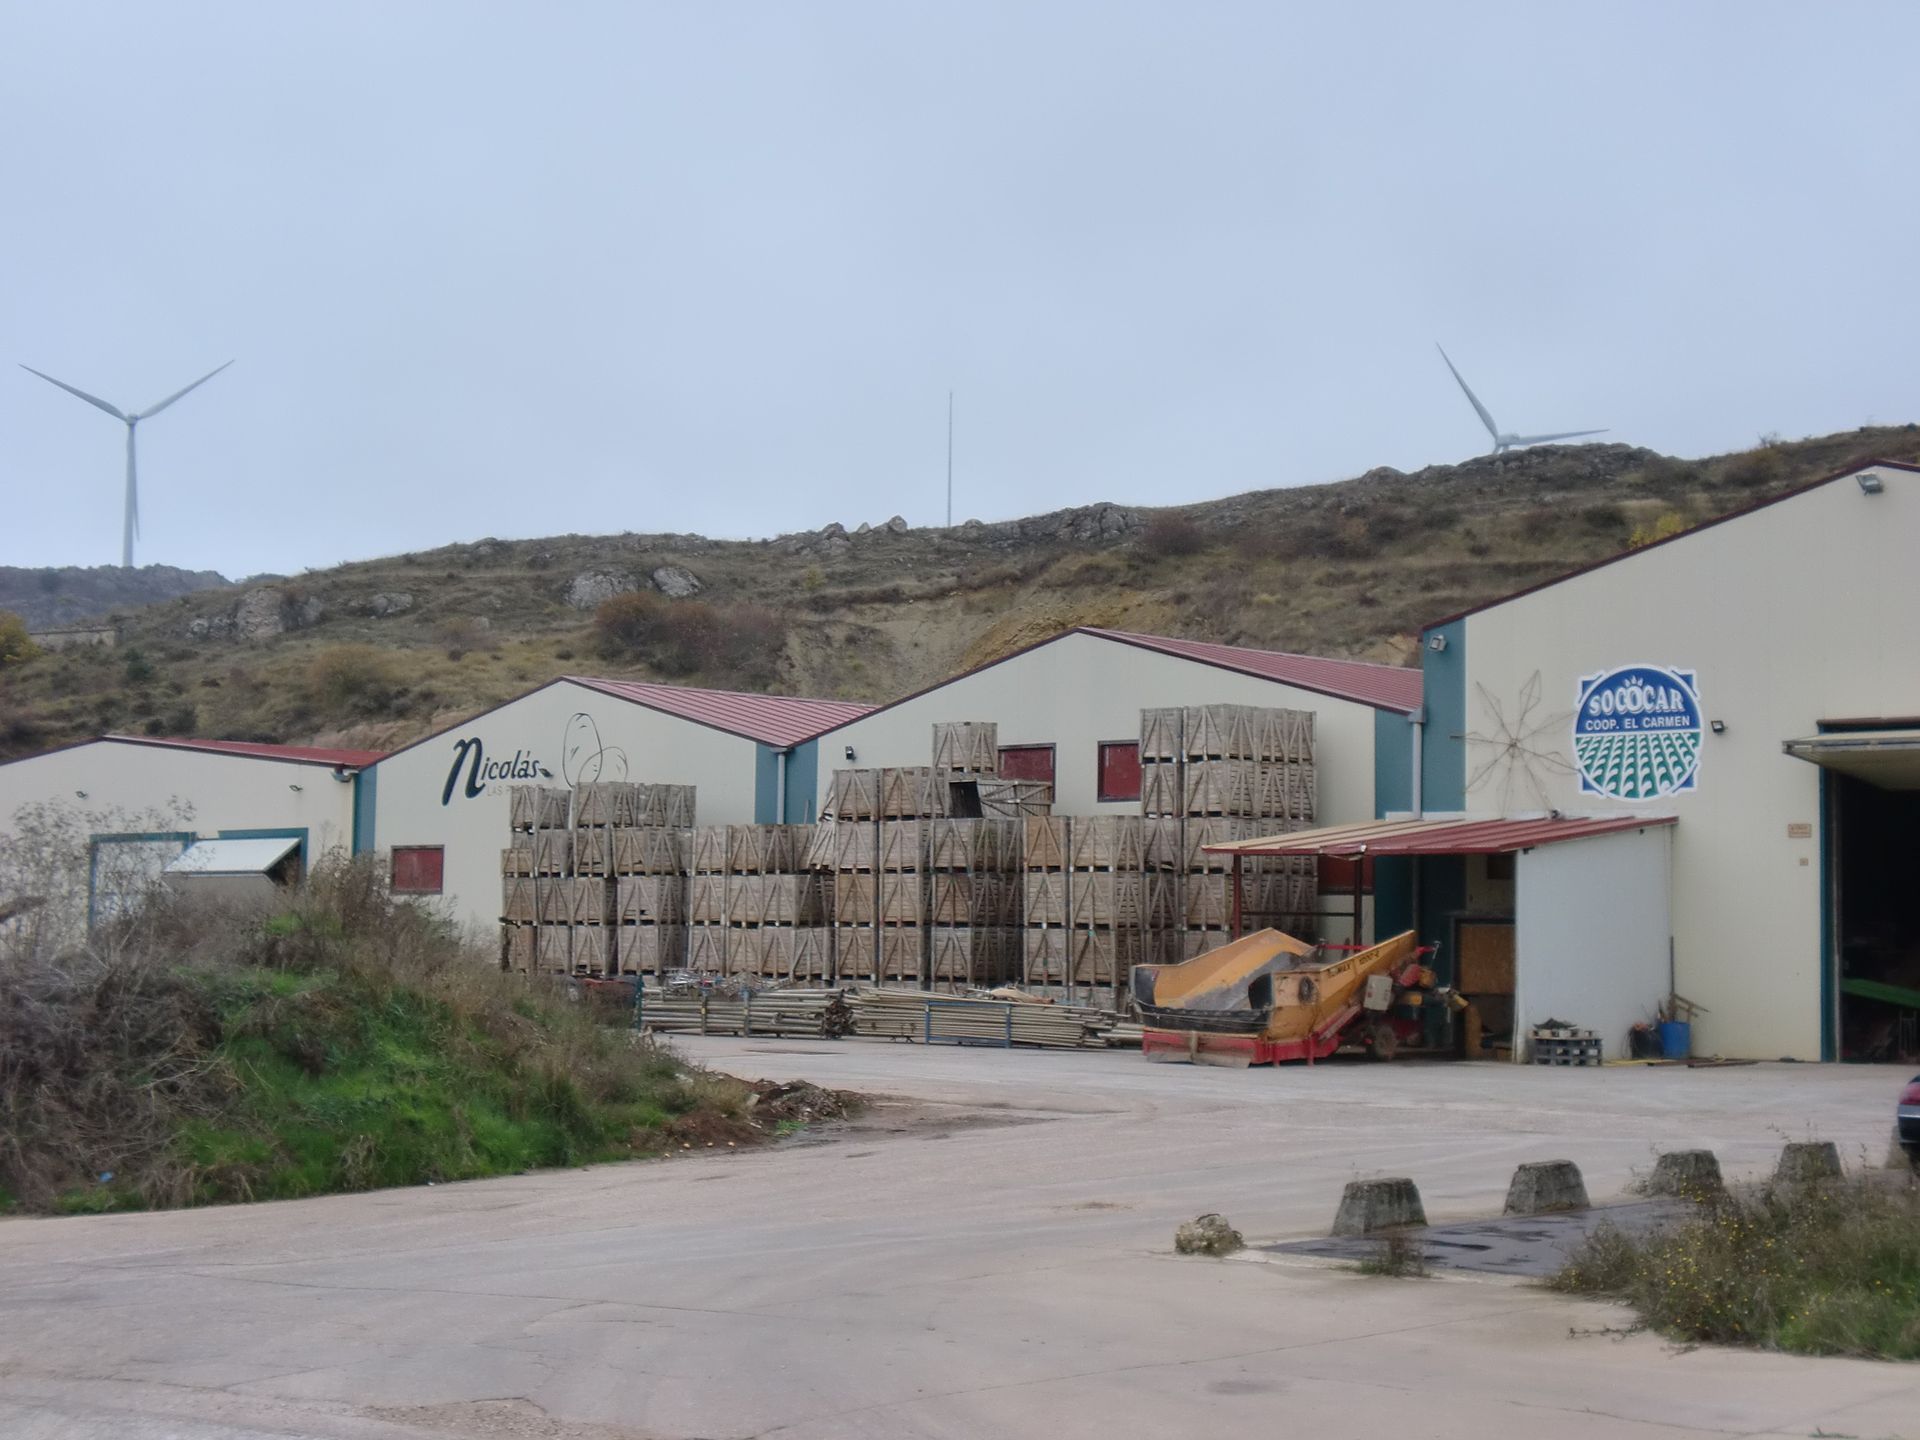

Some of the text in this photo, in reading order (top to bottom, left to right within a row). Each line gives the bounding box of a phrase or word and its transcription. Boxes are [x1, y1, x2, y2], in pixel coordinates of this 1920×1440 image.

[1588, 685, 1685, 716] SOCOCAR
[1585, 716, 1690, 731] COOP. EL CARMEN
